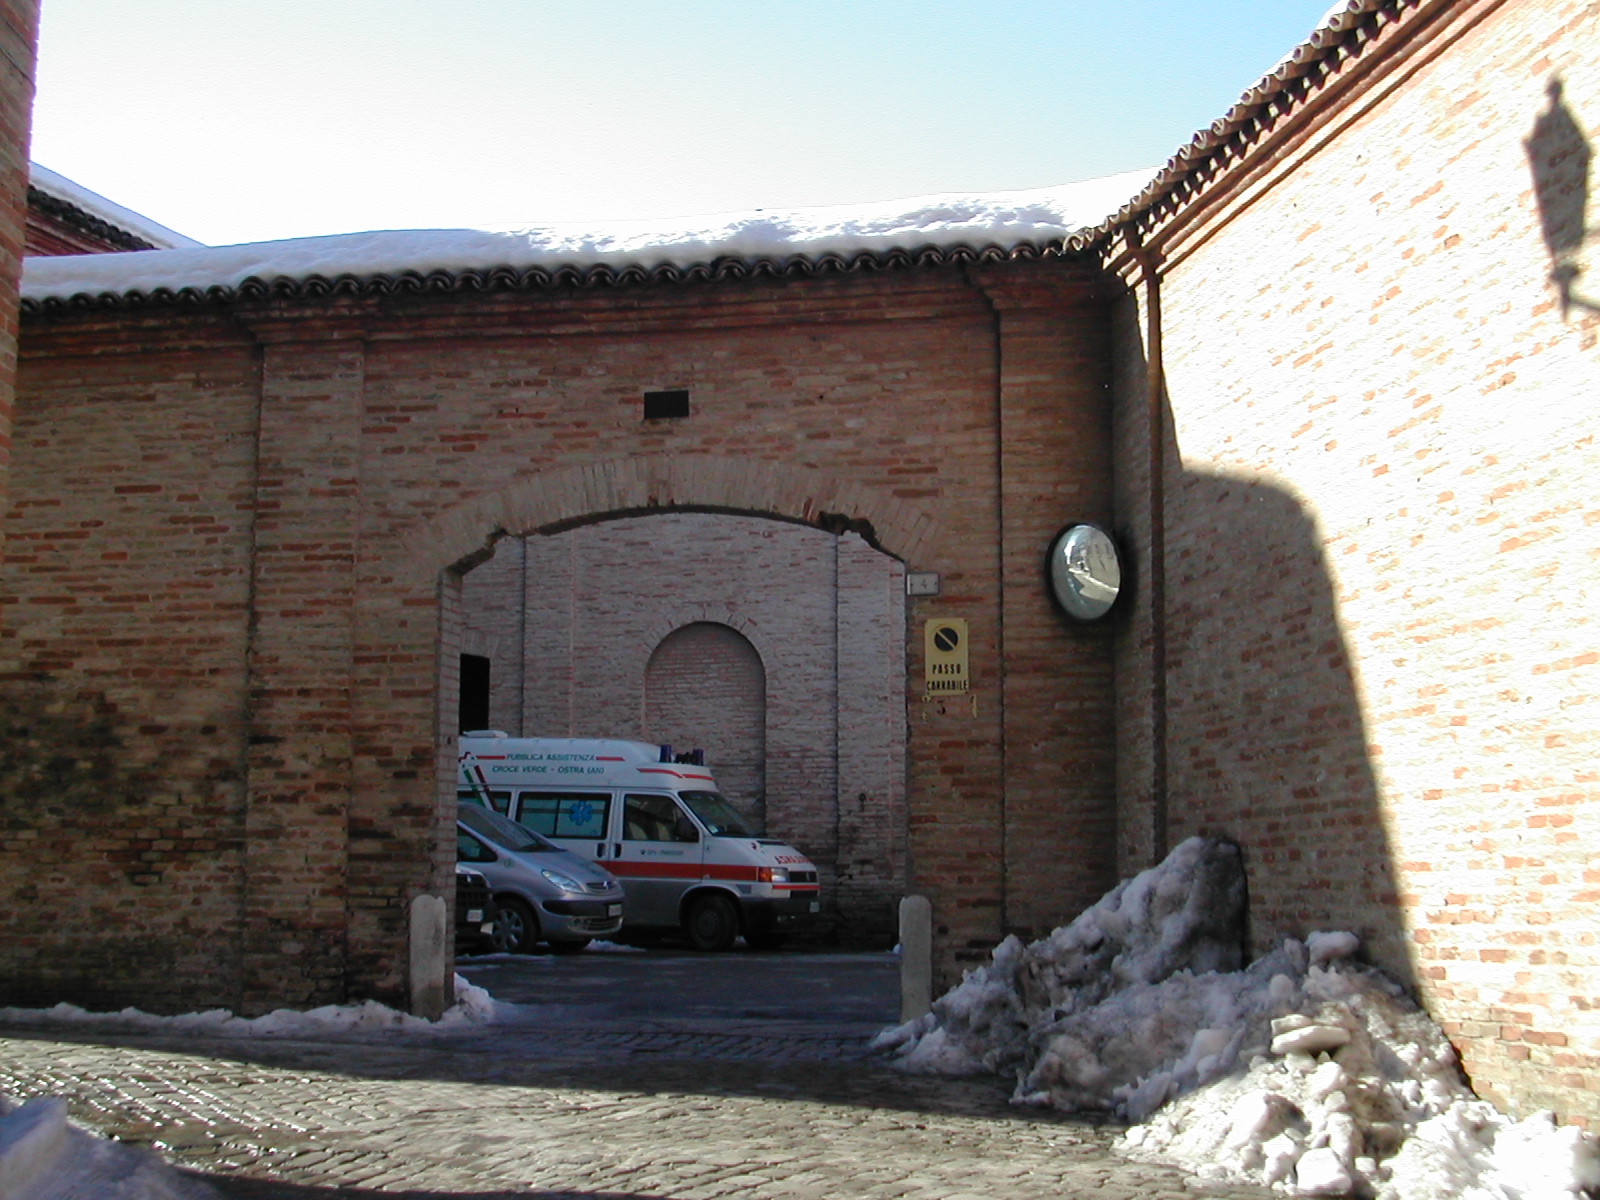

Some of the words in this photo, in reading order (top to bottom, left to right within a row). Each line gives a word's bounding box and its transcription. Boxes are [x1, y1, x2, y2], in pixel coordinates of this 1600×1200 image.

[920, 578, 927, 590] 4
[932, 663, 961, 674] PASSO
[927, 680, 968, 691] CARRABILE
[506, 753, 544, 761] PUBBLICA
[547, 753, 595, 761] ASSISTENZA
[492, 765, 519, 773] CROCE
[522, 765, 548, 773] VERDE
[557, 766, 585, 774] OSTRA
